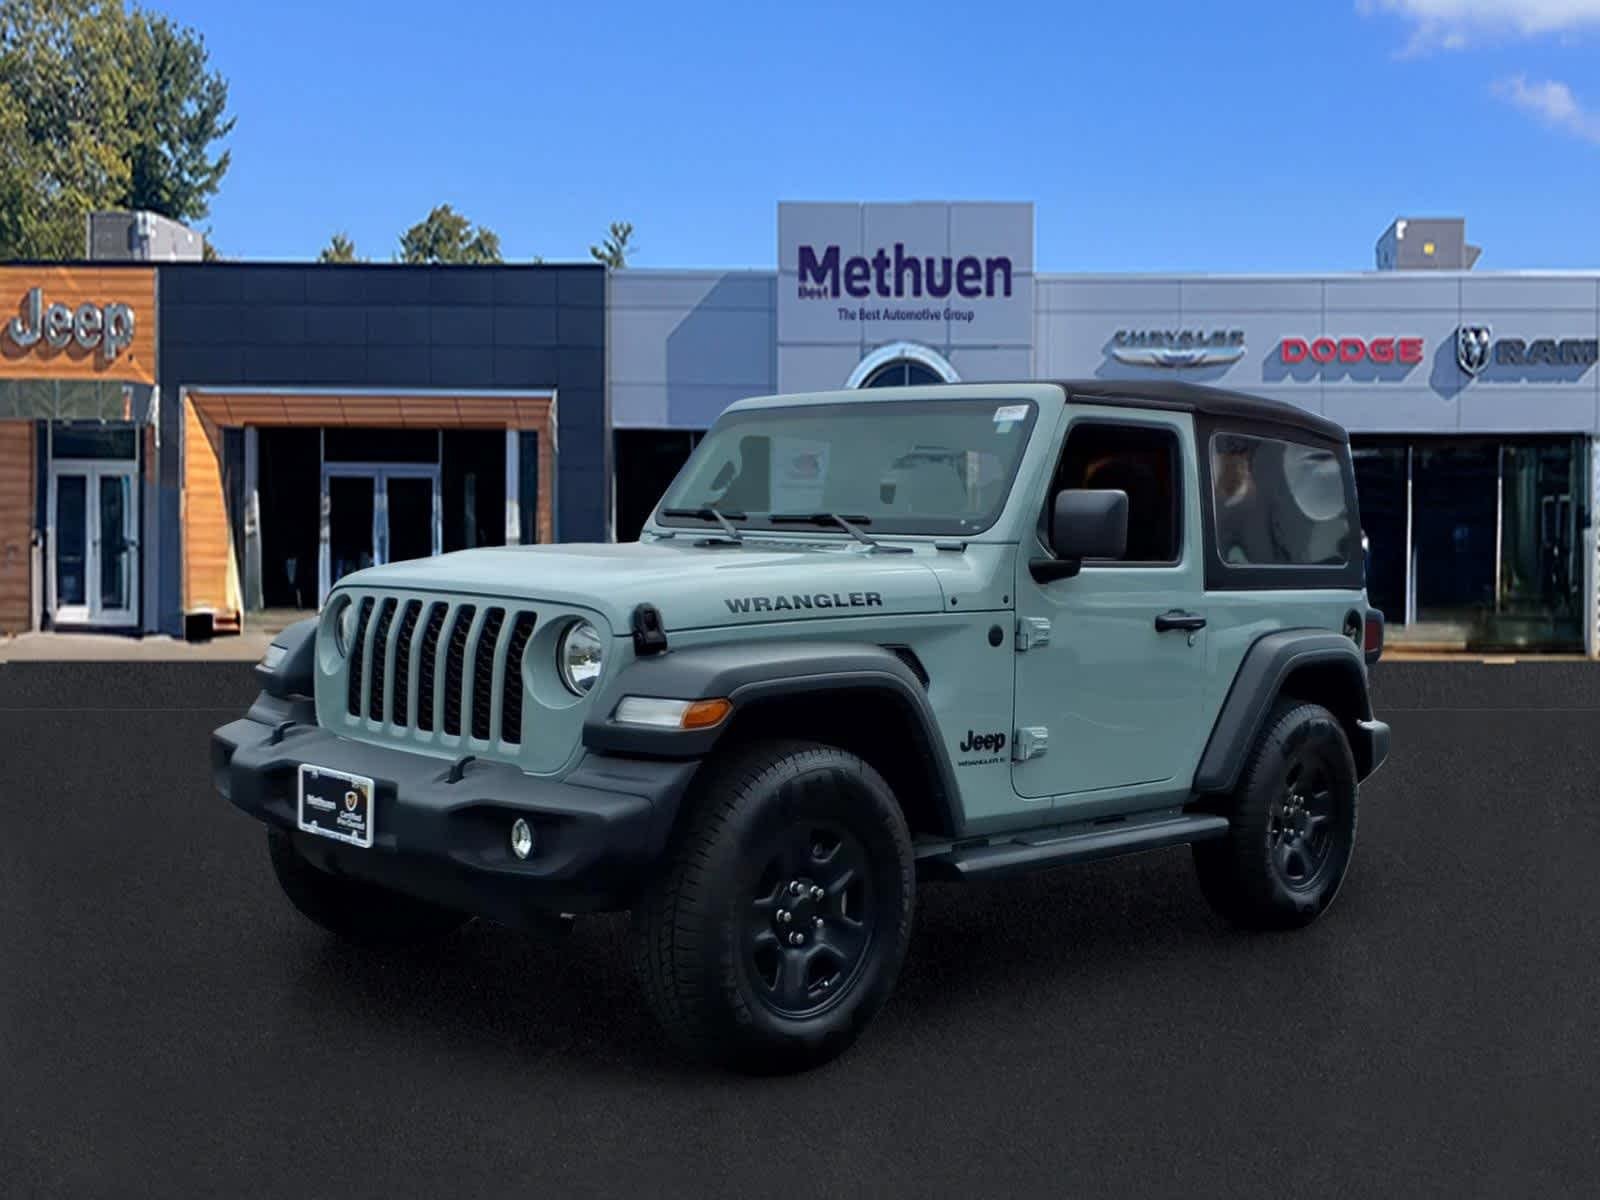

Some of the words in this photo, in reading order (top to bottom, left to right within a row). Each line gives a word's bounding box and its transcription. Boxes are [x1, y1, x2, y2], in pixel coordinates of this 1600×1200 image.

[798, 243, 1012, 298] Methuen
[9, 288, 135, 359] Jeep
[838, 308, 857, 321] The
[859, 308, 881, 321] Best
[883, 308, 941, 321] Automotive
[943, 308, 975, 323] Group
[1114, 330, 1244, 348] CHRYSLER
[1282, 337, 1424, 364] DODGE
[1495, 338, 1598, 365] RAM
[724, 591, 883, 613] WRANGLER
[960, 730, 1006, 753] Jeep
